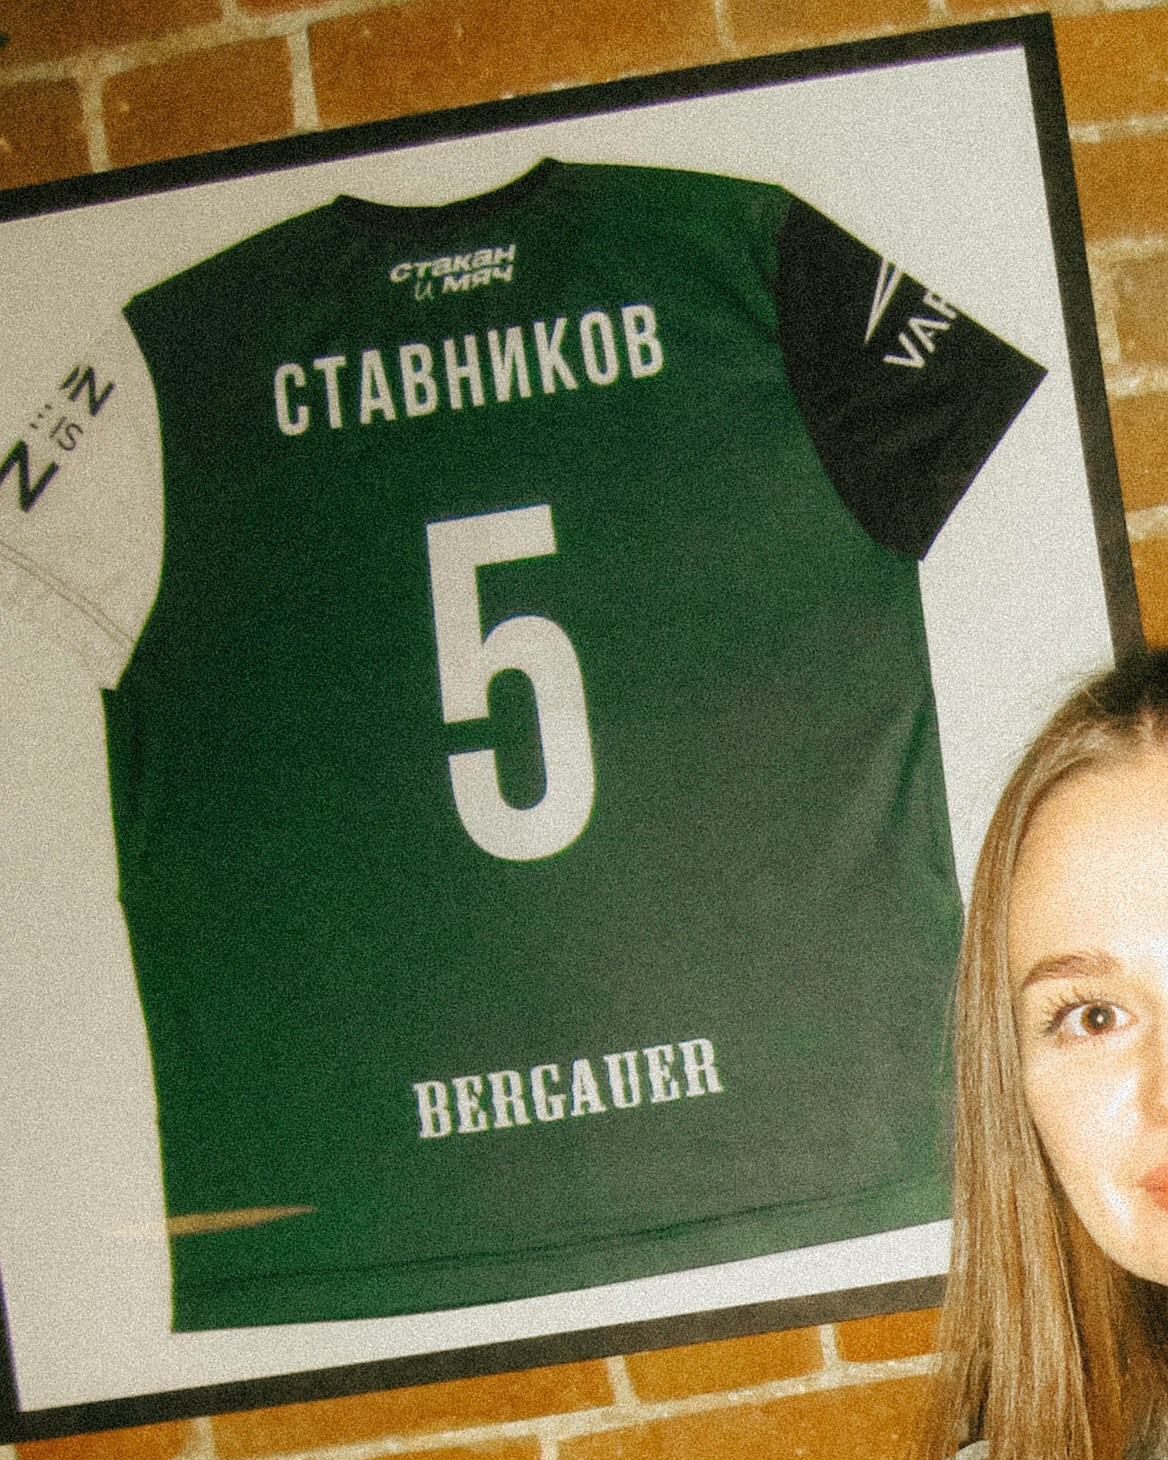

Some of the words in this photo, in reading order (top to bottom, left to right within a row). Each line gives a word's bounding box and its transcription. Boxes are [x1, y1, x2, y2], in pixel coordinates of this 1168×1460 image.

[272, 303, 665, 438] СТАВНИКОВ
[425, 503, 597, 863] 5
[411, 1037, 724, 1142] BERGAUER
